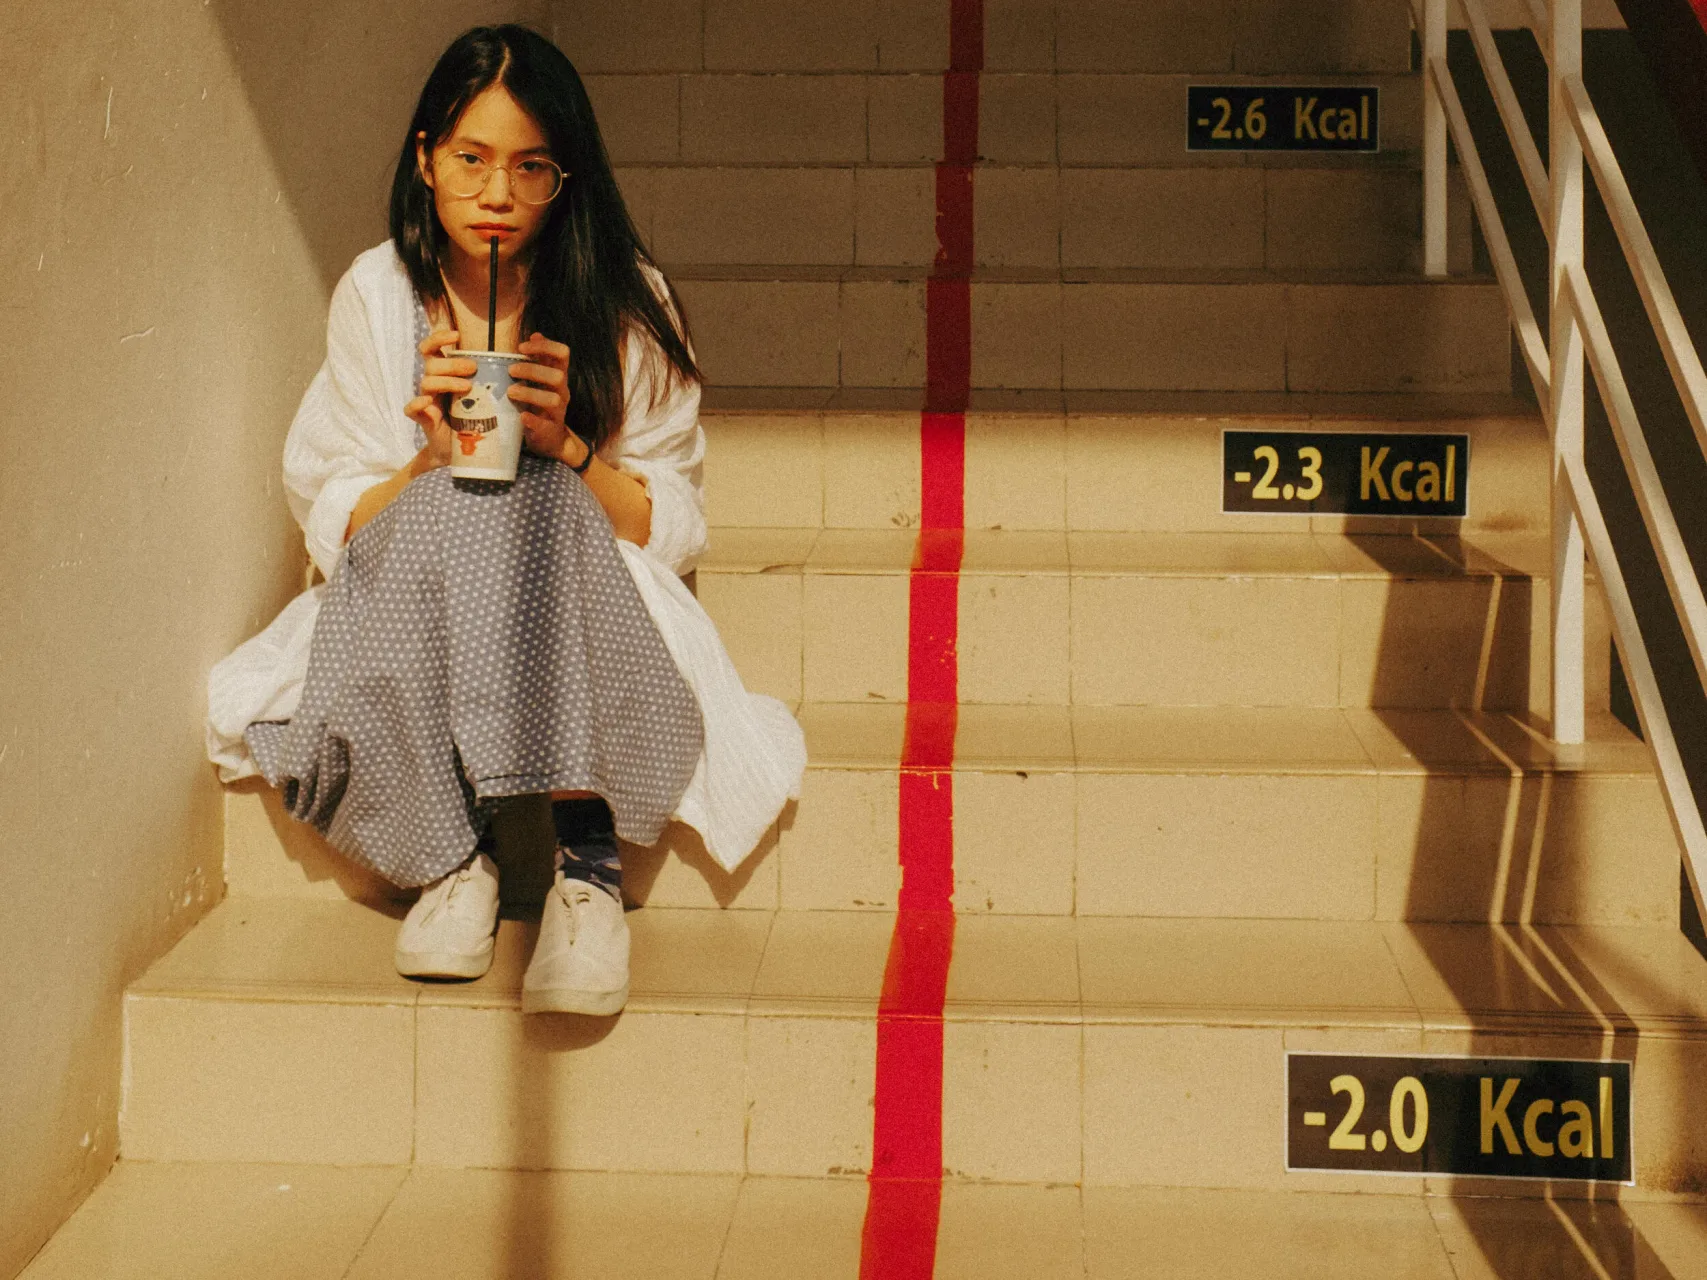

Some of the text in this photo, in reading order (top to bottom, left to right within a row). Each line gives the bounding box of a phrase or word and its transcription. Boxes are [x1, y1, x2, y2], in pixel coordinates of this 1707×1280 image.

[1197, 95, 1369, 140] -2.6 Kcal
[1234, 444, 1456, 502] -2.3 Kcal
[1303, 1074, 1614, 1159] -2.0 Kcal
